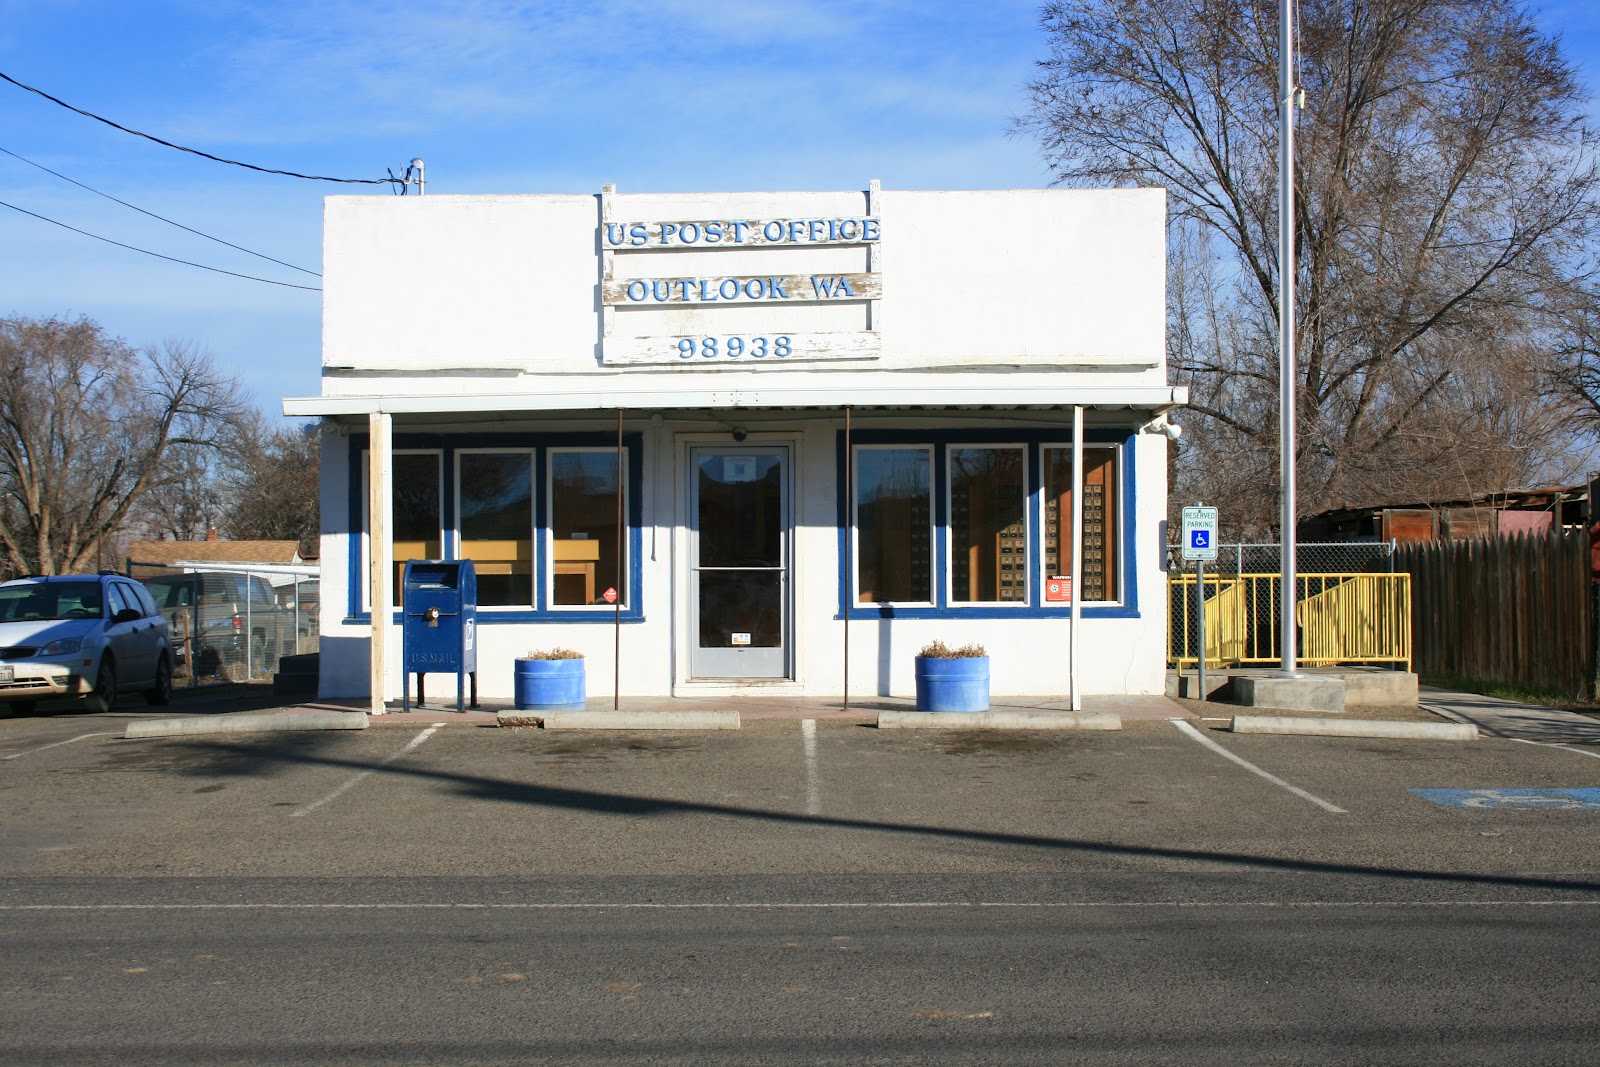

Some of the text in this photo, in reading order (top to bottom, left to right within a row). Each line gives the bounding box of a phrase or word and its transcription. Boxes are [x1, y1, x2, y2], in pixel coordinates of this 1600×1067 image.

[607, 219, 881, 246] US POST OFFICE
[628, 276, 854, 301] OUTLOOK WA
[678, 336, 793, 359] 98938
